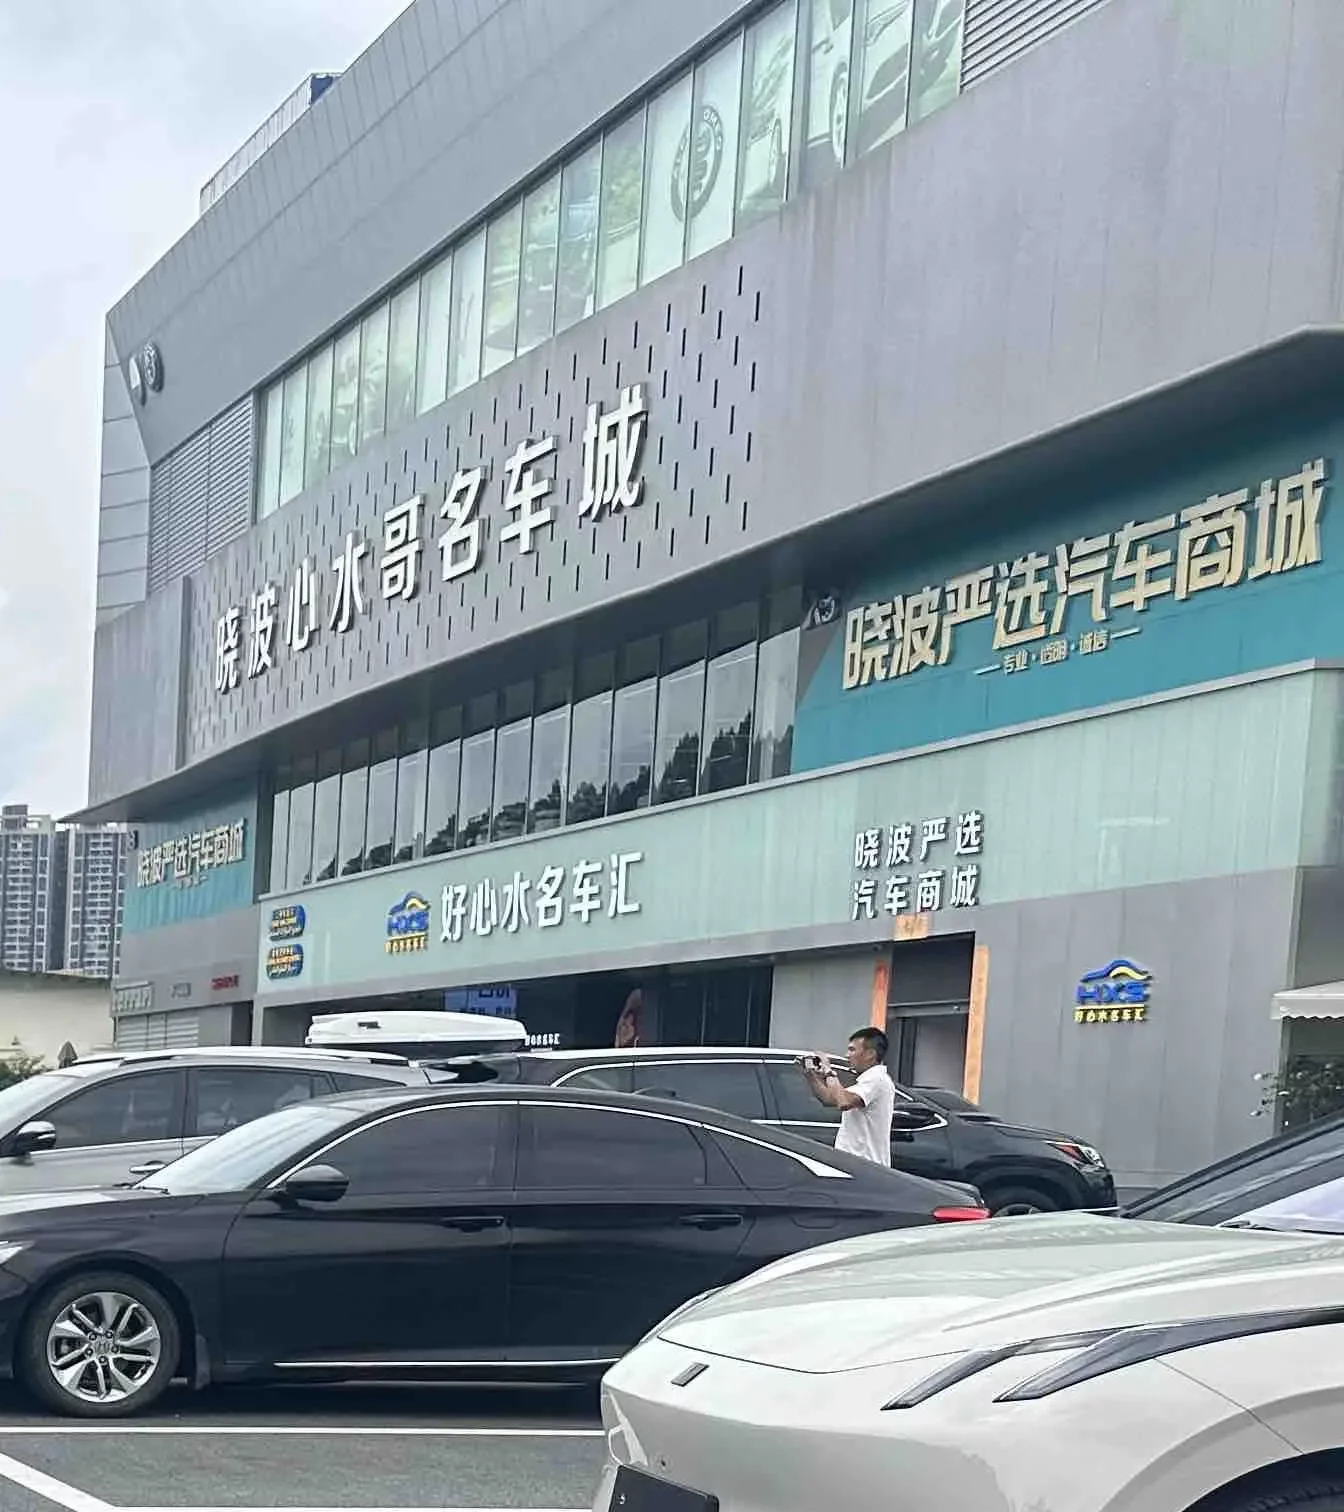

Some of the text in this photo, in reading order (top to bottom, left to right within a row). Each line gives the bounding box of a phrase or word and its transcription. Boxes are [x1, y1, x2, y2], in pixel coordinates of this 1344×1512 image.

[214, 383, 649, 694] 晓波心水哥名车城
[842, 457, 1327, 691] 晓波严选汽车商城
[854, 810, 985, 872] 晓波严选
[440, 851, 644, 942] 好心水名车汇
[850, 865, 982, 921] 汽车商城
